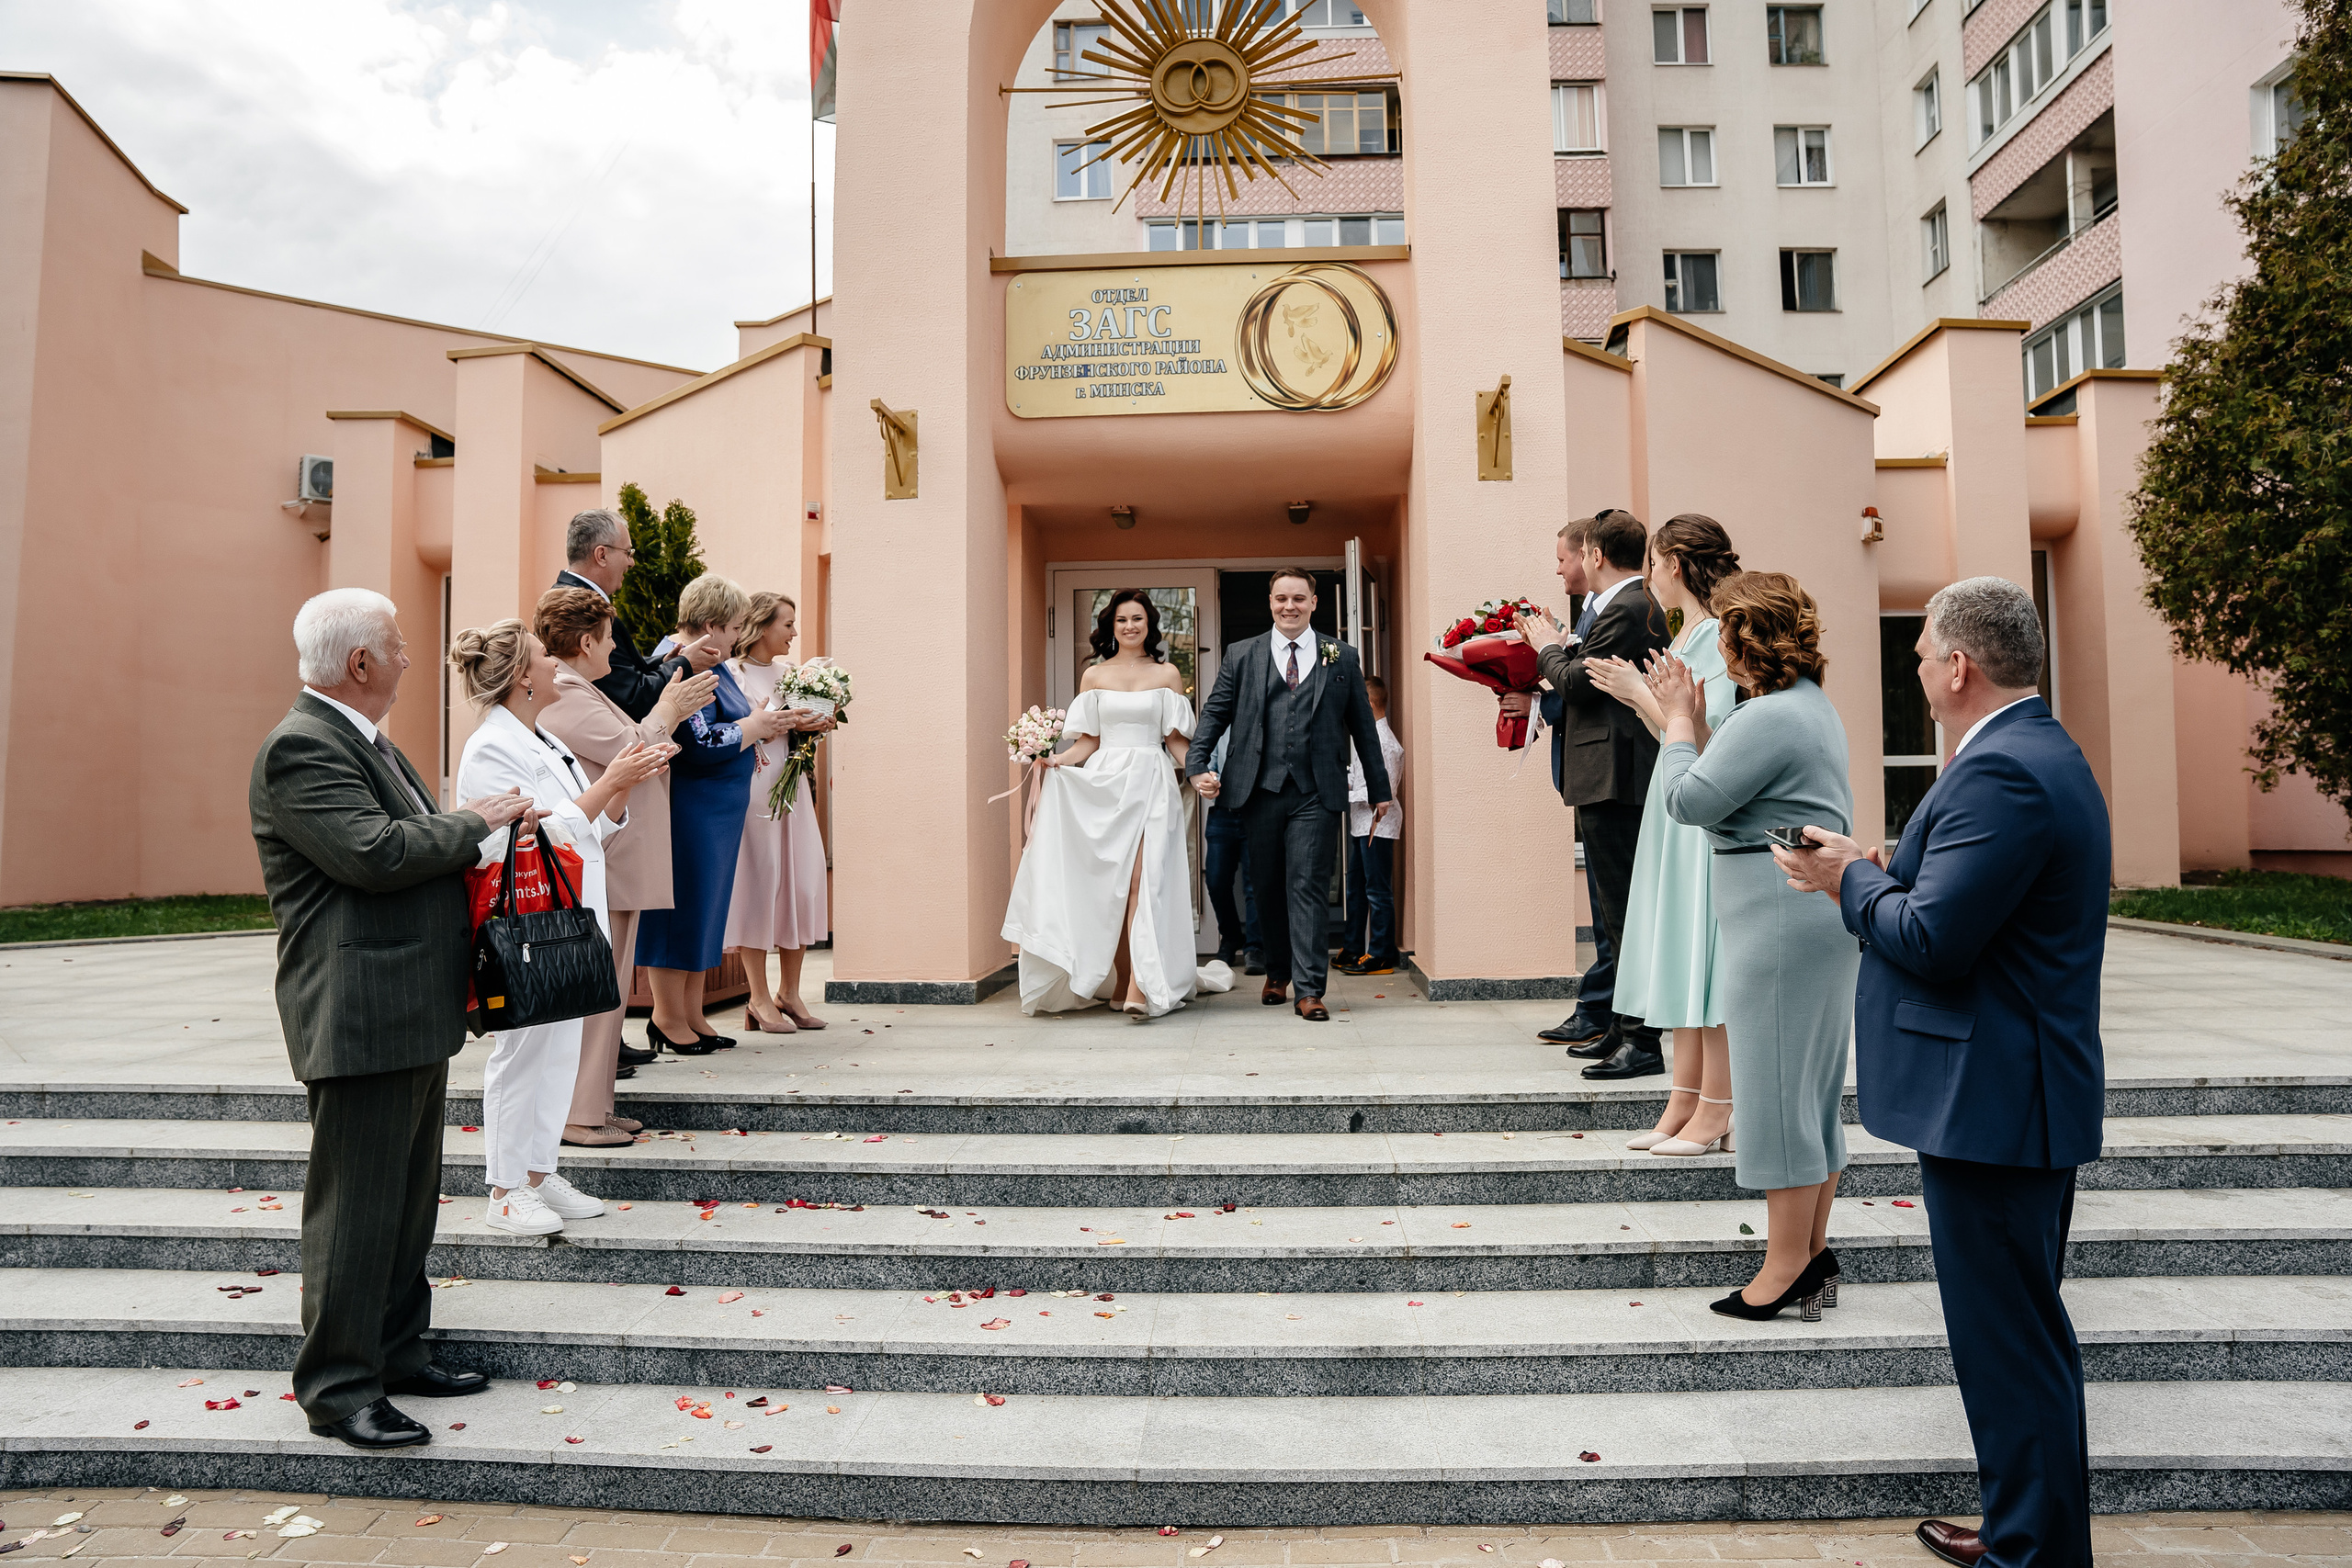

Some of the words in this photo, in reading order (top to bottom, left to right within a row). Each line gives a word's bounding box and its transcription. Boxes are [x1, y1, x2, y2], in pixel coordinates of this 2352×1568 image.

[1091, 288, 1148, 305] ОТДЕЛ
[1069, 305, 1171, 341] ЗАГС
[1041, 340, 1200, 361] АДМИНИСТРАЦИИ
[1014, 361, 1151, 380] ФРУНЗЕНСКОГО
[1155, 357, 1227, 375] РАЙОНА
[1076, 388, 1086, 399] г.
[1090, 381, 1165, 398] МИНСКА
